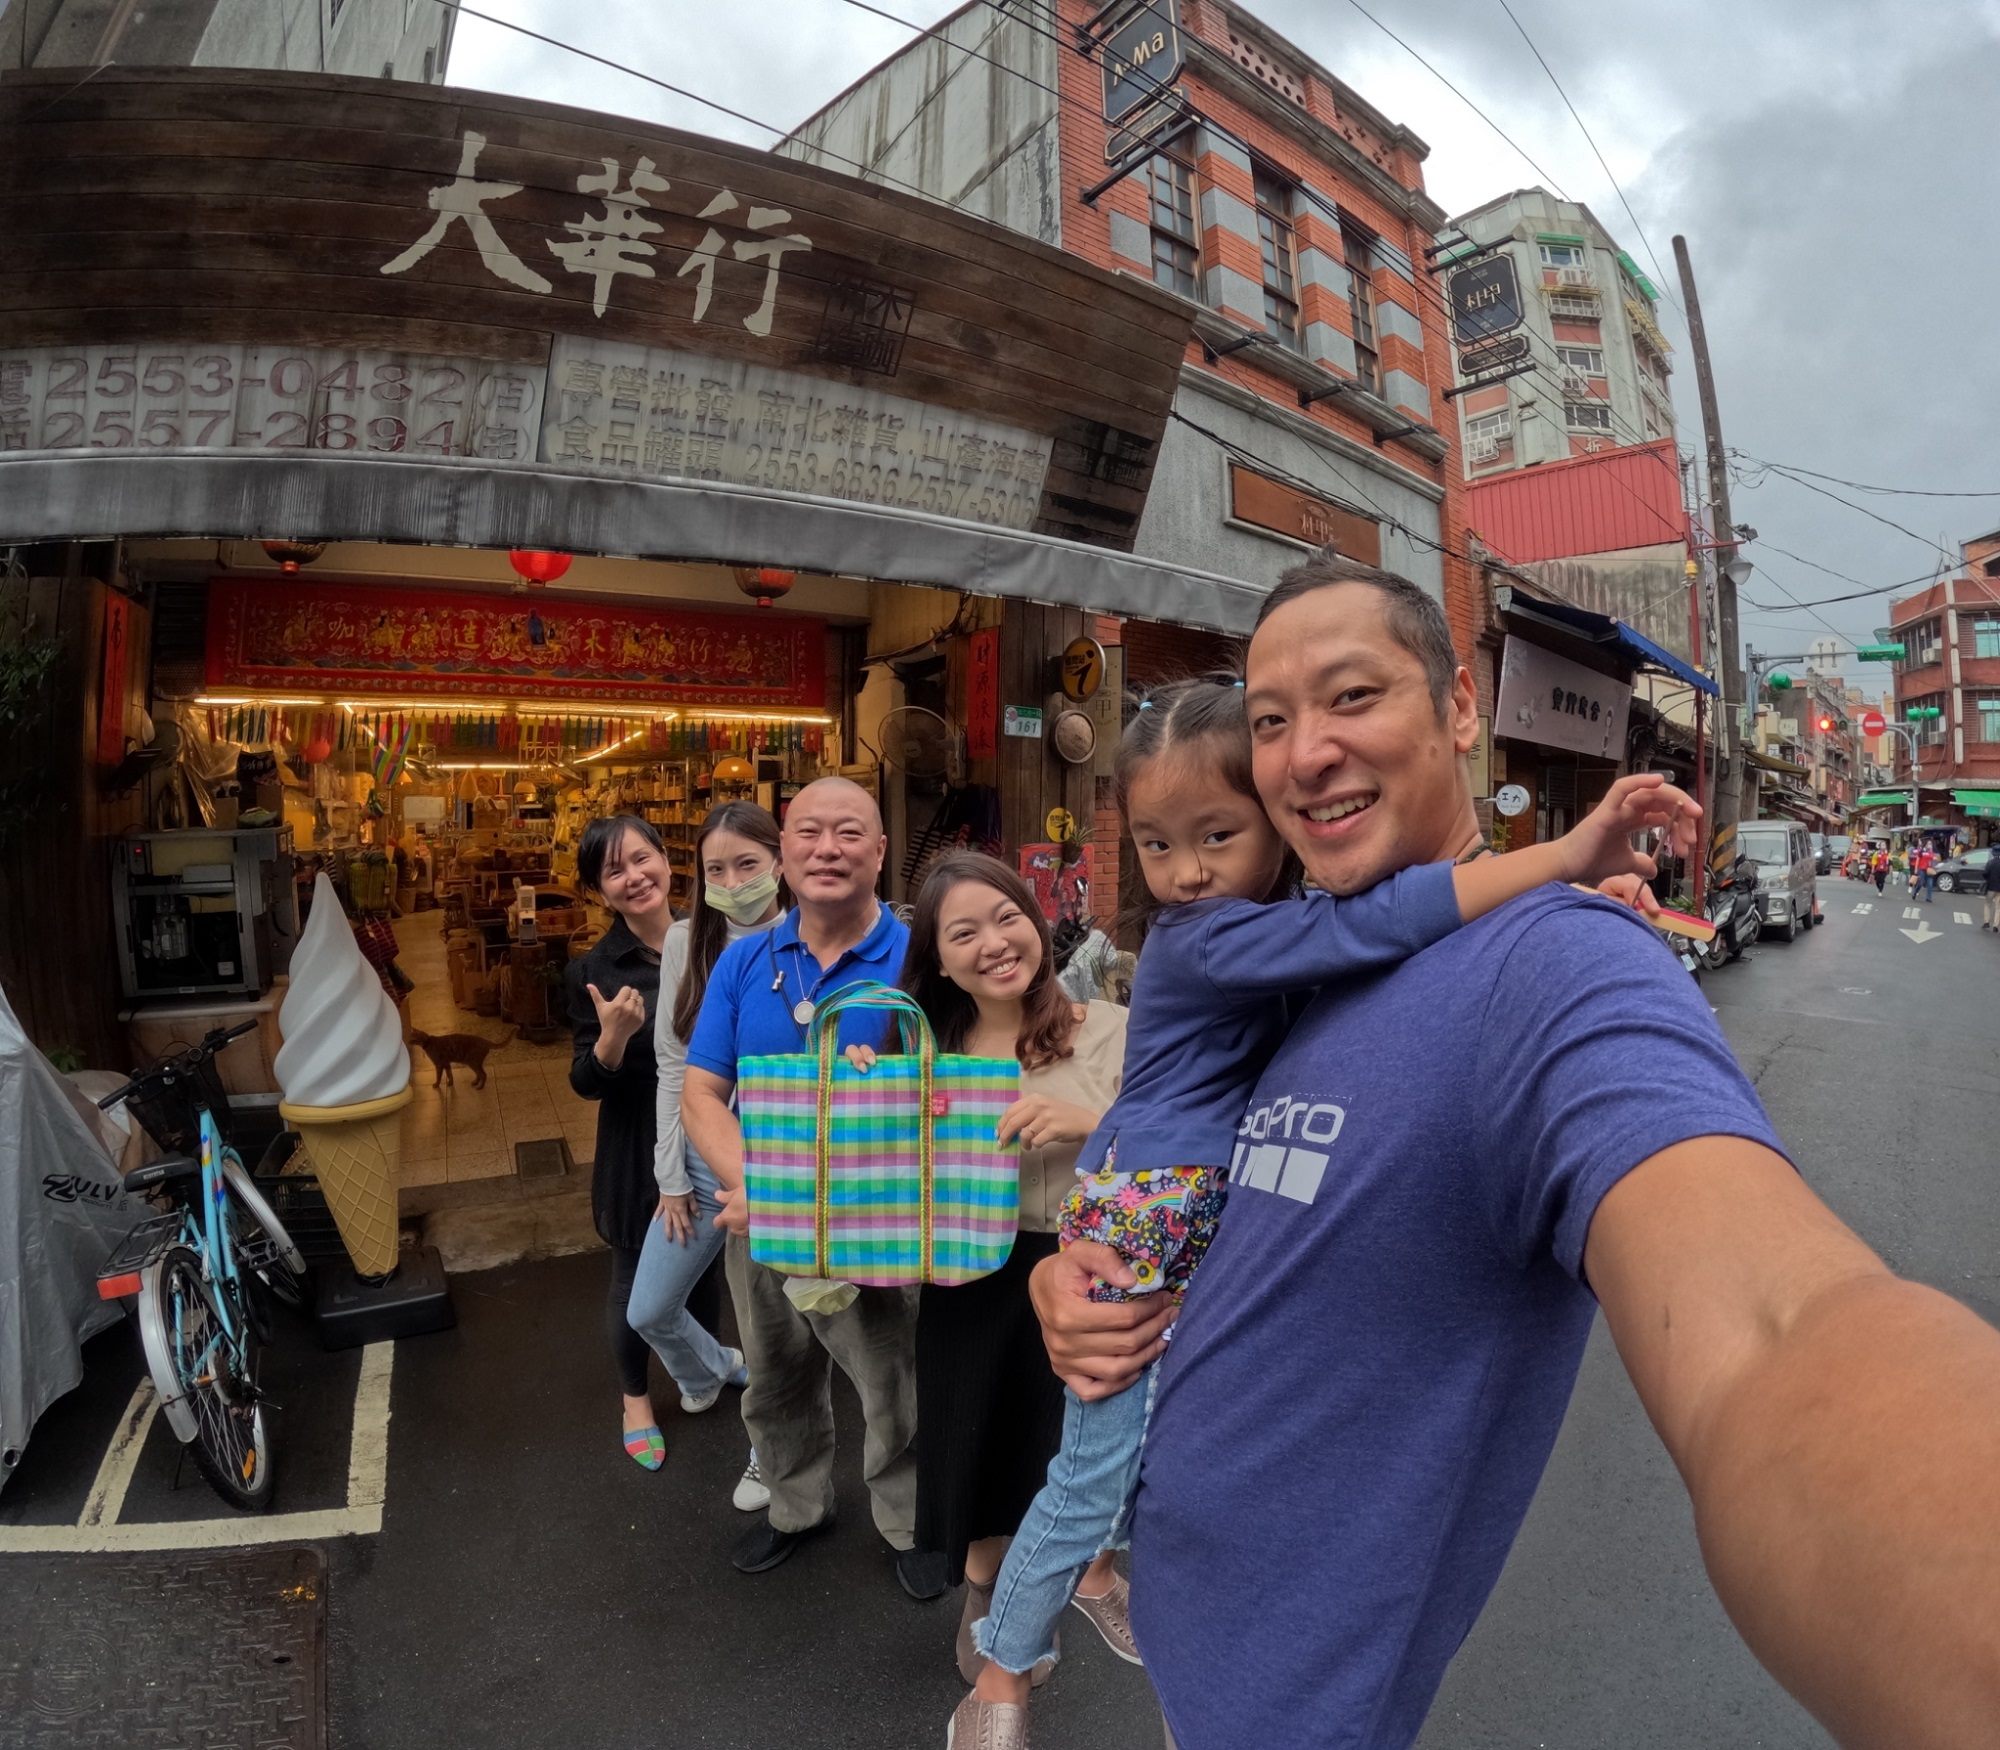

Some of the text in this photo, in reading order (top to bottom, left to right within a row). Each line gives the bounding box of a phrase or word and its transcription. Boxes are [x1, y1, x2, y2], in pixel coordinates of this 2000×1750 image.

[379, 130, 813, 337] 大華行
[1018, 719, 1038, 735] 161
